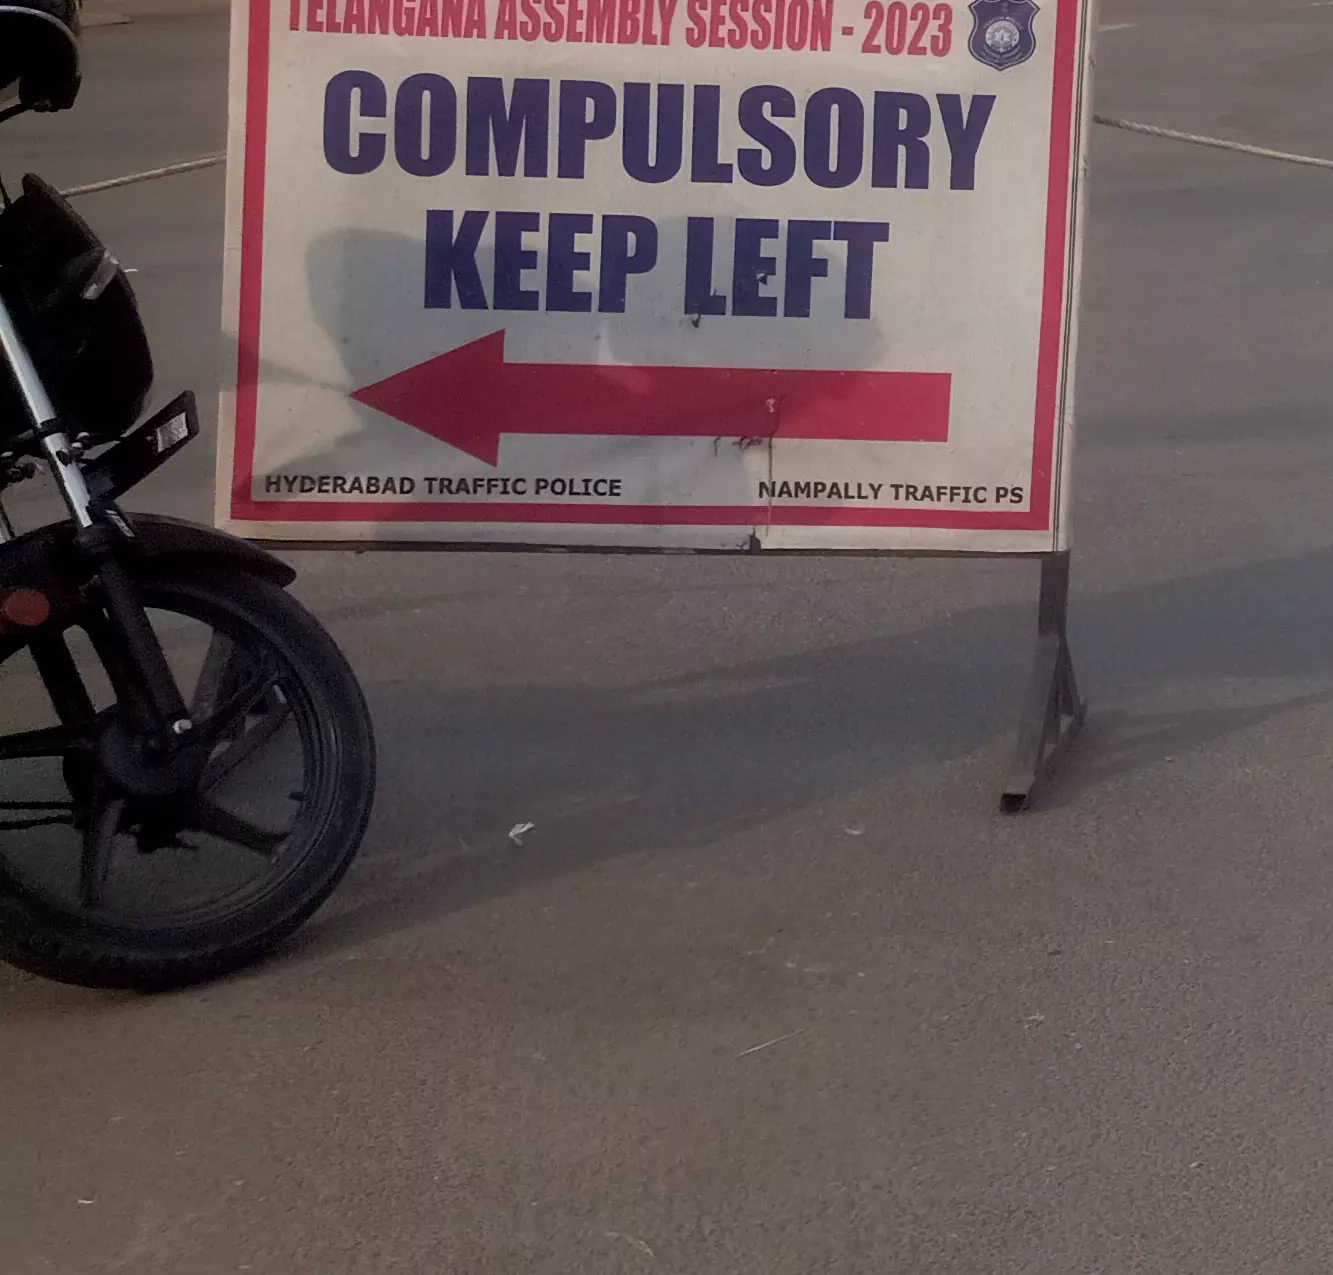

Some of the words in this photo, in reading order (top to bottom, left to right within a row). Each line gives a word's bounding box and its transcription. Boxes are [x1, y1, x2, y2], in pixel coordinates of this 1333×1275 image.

[862, 1, 953, 57] 2023
[322, 70, 997, 191] COMPULSORY
[424, 209, 658, 315] KEEP
[684, 216, 889, 320] LEFT
[265, 475, 415, 498] HYDERABAD
[423, 476, 530, 497] TRAFFIC
[535, 477, 622, 497] POLICE
[758, 482, 884, 503] NAMPALLY
[891, 483, 988, 504] TRAFFIC
[995, 486, 1024, 505] PS
